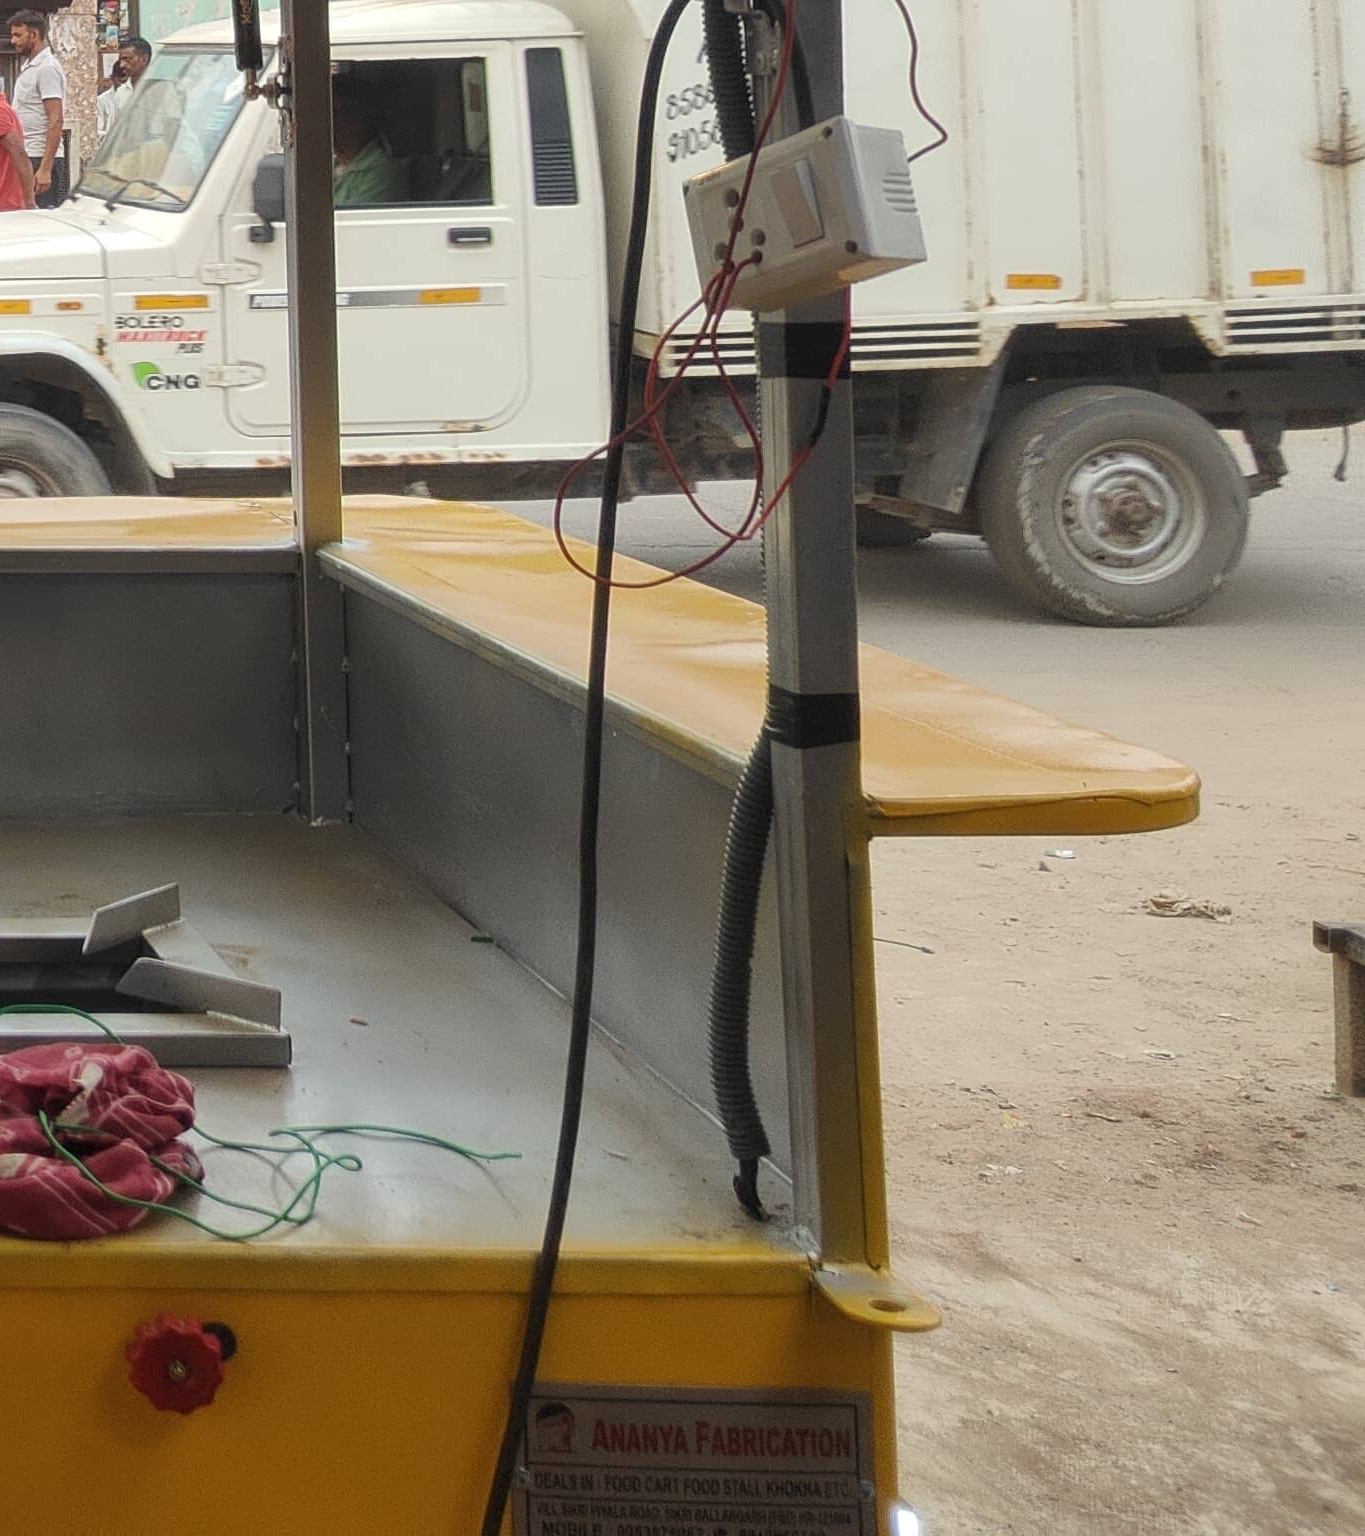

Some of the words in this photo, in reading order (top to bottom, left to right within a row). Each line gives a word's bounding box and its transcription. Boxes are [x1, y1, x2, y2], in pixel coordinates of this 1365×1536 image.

[114, 315, 184, 329] BOLERO
[146, 374, 201, 390] CNG
[591, 1416, 686, 1456] ANANYA
[696, 1421, 852, 1459] FABRICATION
[534, 1470, 577, 1490] DEALS
[604, 1475, 642, 1492] FOOD
[645, 1476, 679, 1494] CART
[683, 1478, 719, 1496] FOOD
[766, 1480, 821, 1498] KHOKHA
